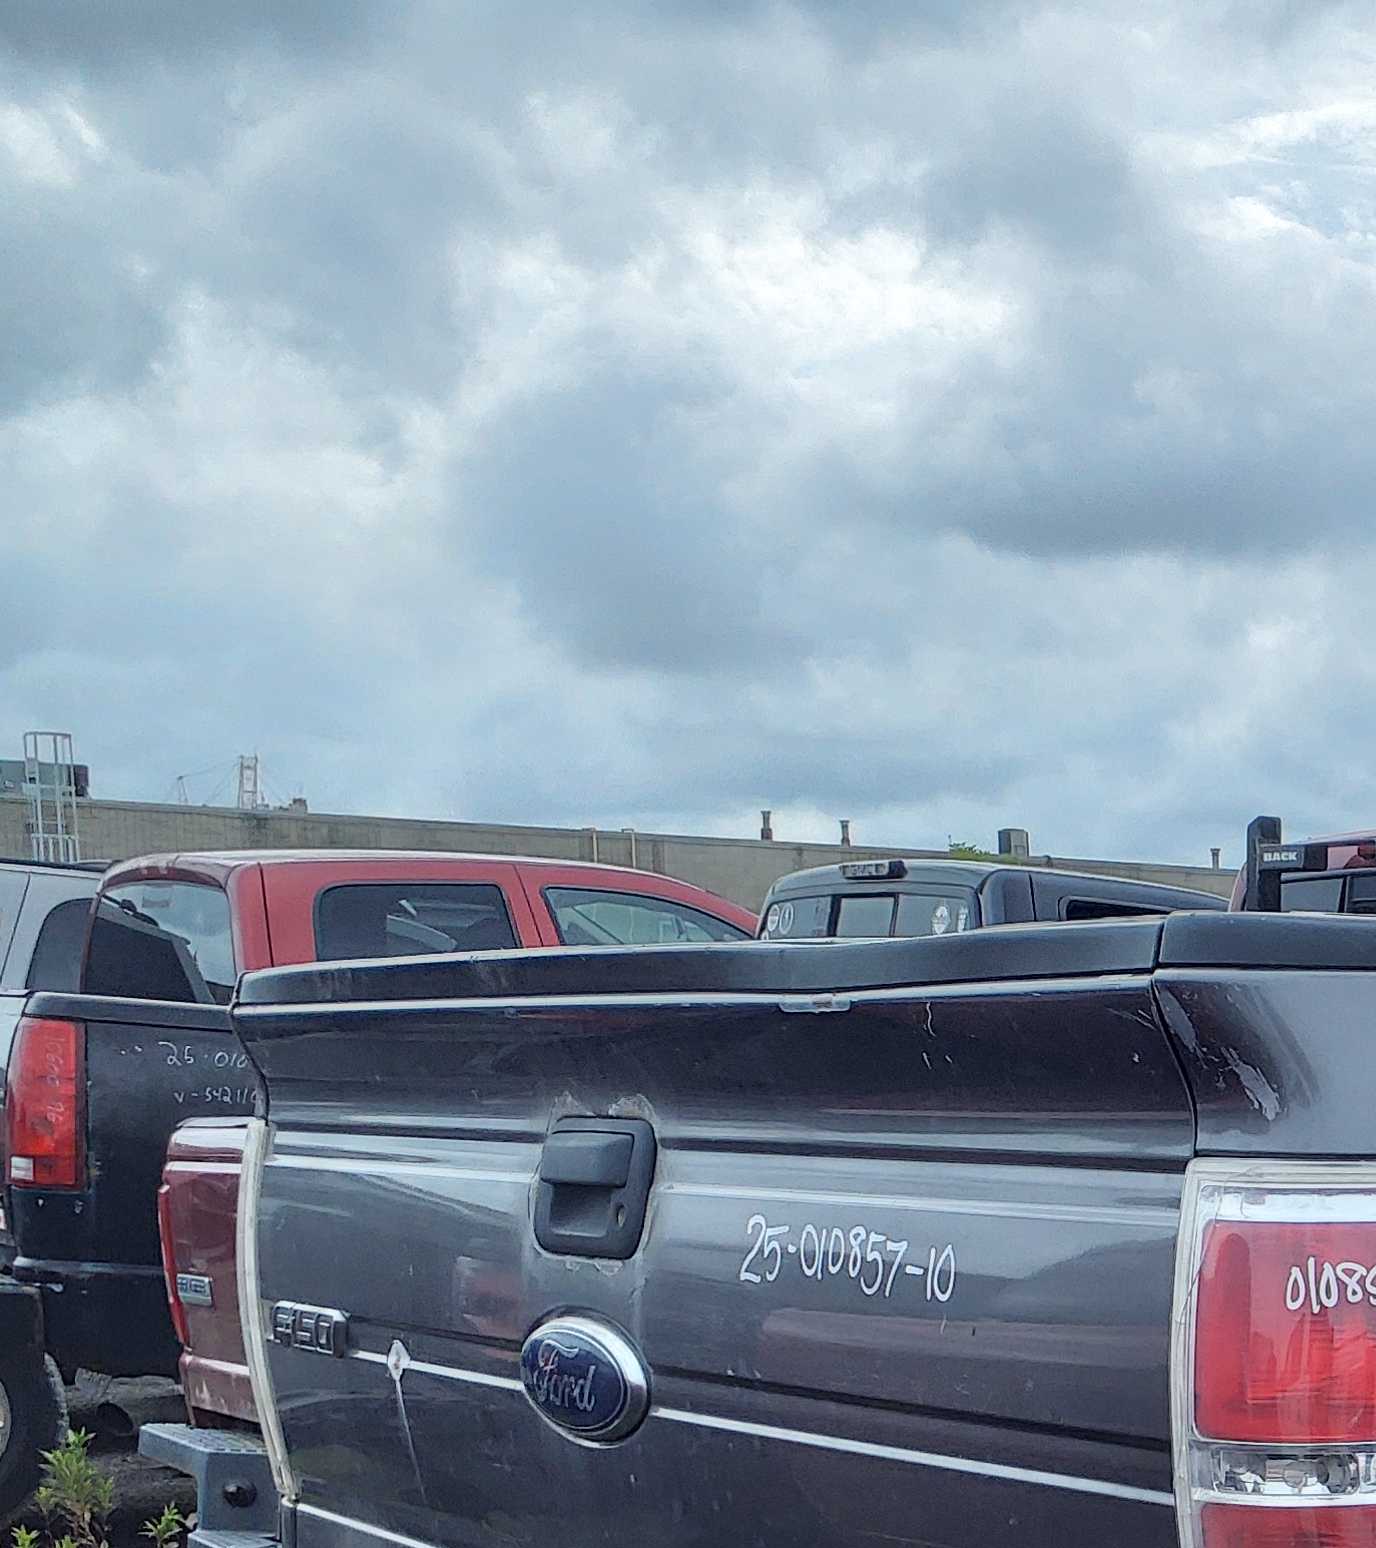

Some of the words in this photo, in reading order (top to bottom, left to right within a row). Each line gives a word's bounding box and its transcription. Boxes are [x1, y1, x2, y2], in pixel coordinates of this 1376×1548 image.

[1262, 851, 1298, 862] BACK
[738, 1213, 957, 1302] 25-010857-10
[531, 1338, 596, 1413] Ford
